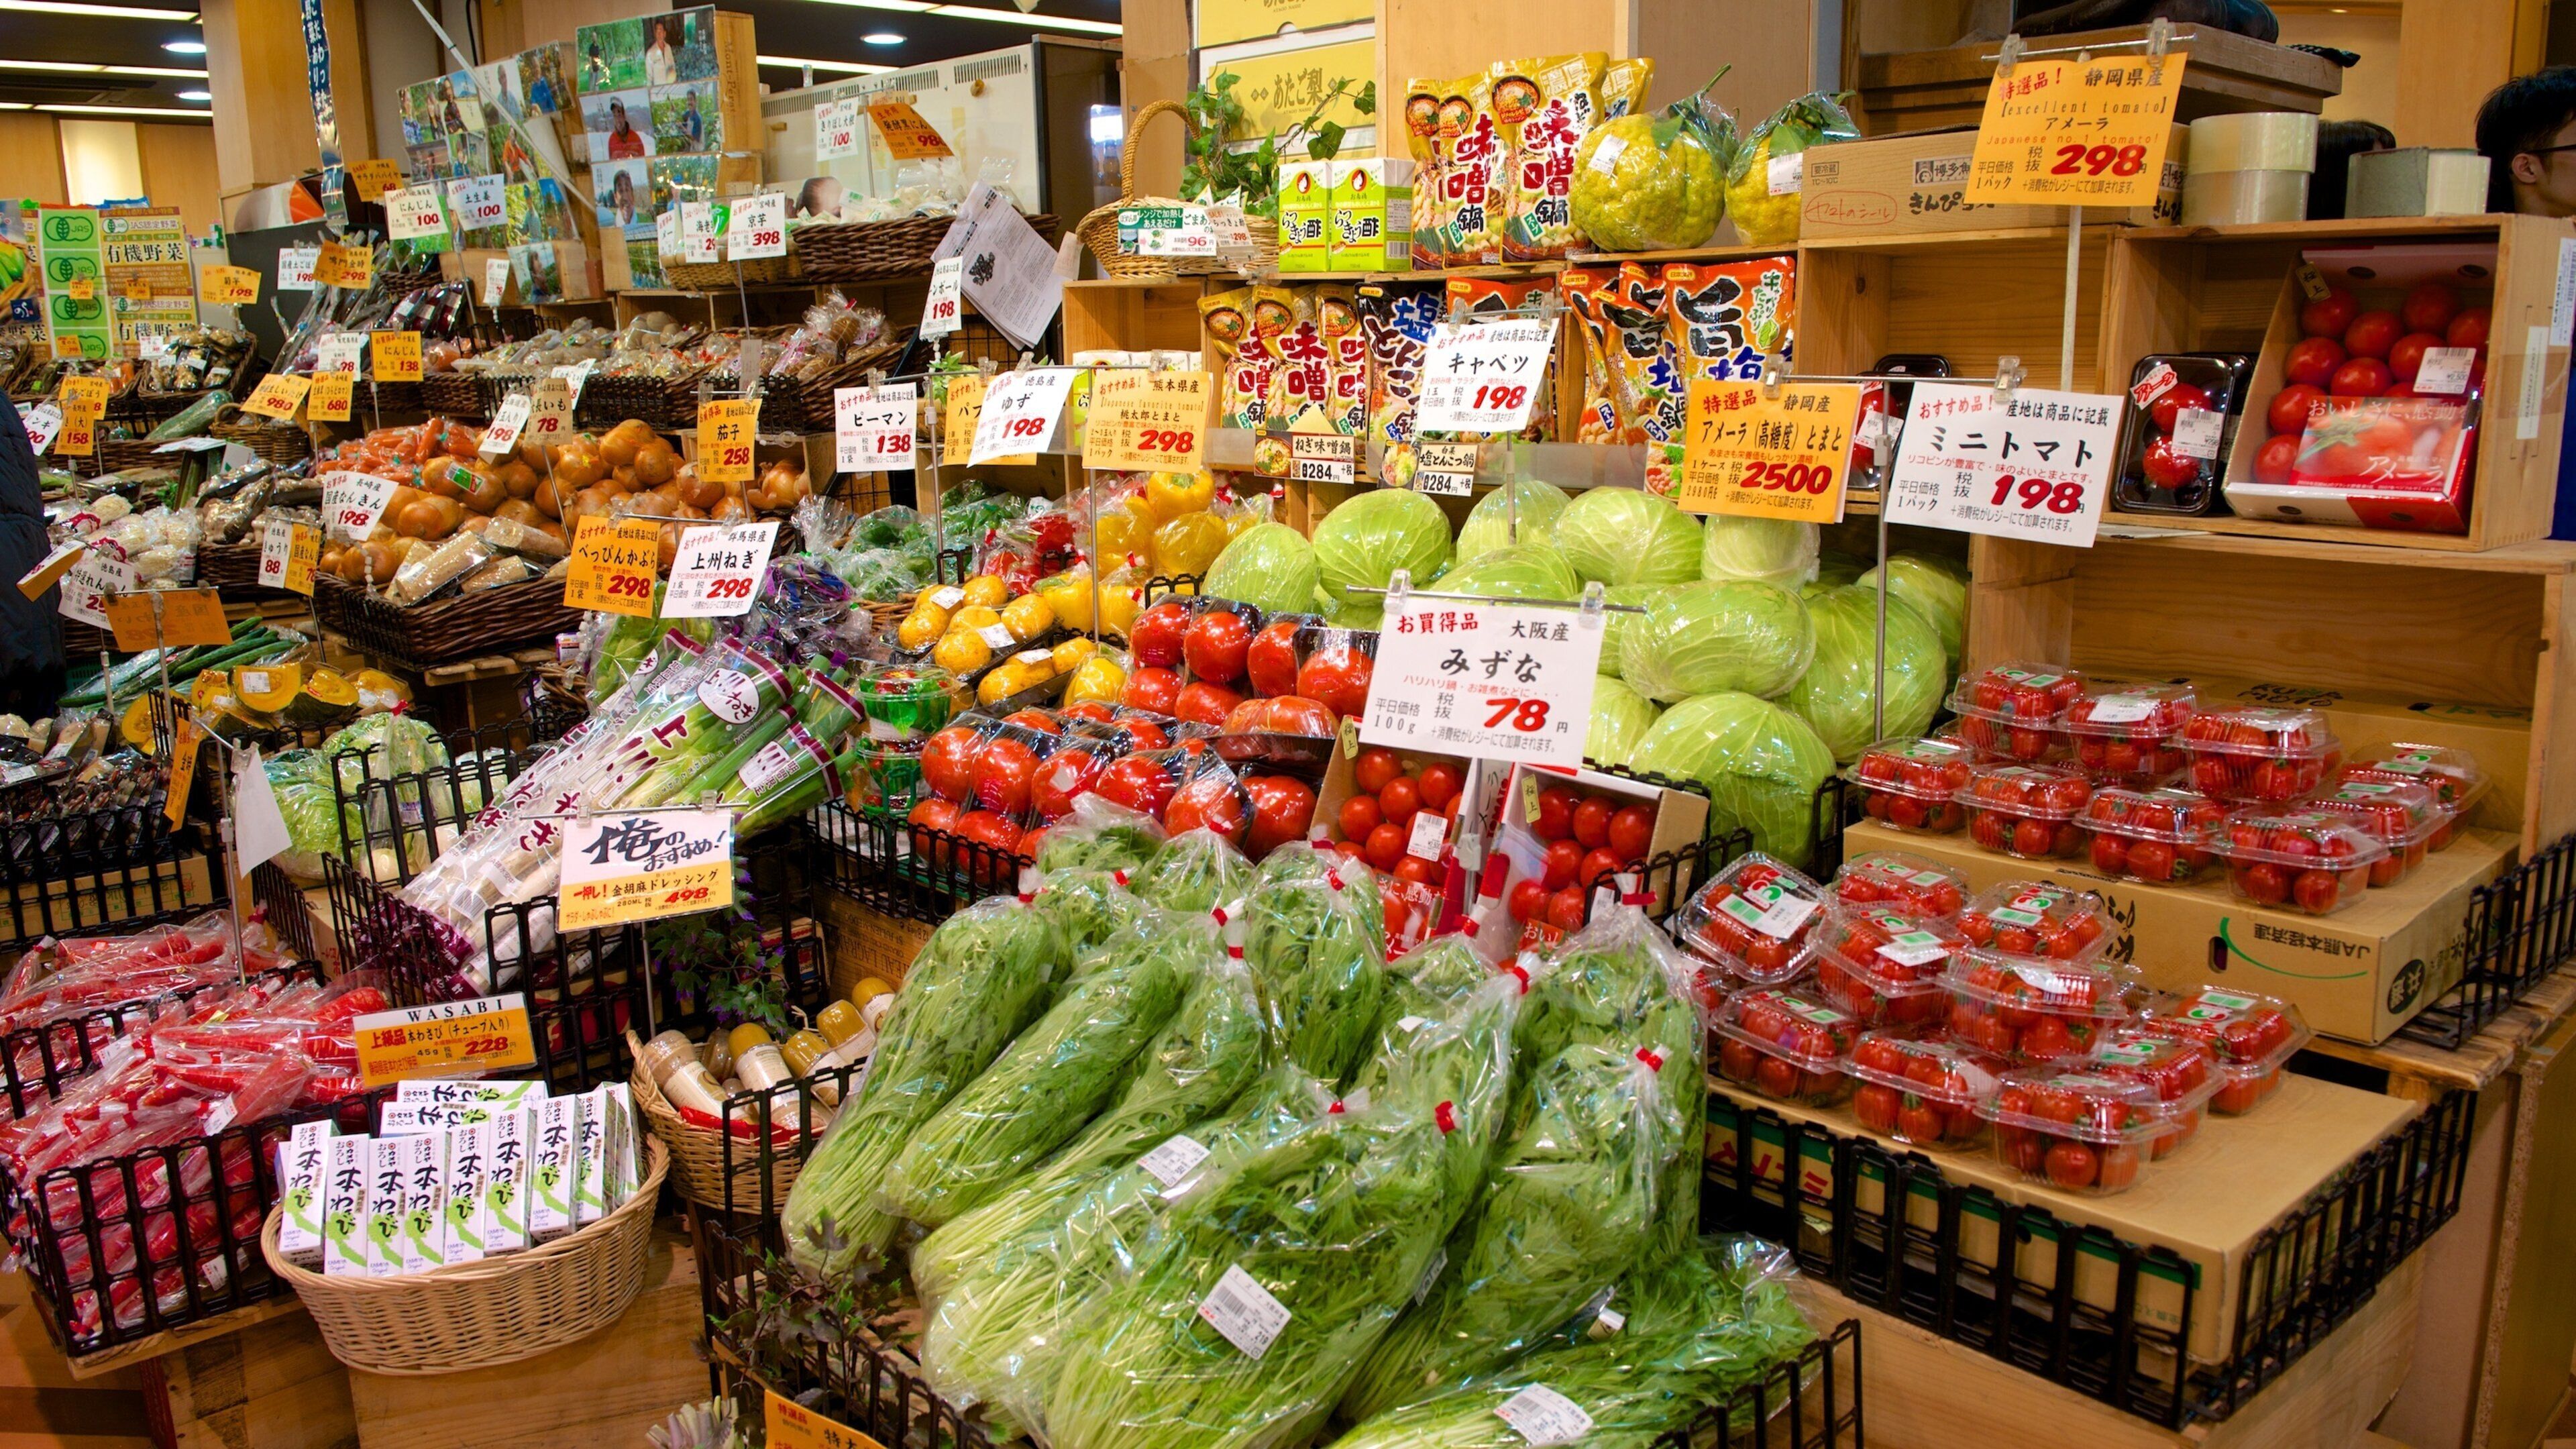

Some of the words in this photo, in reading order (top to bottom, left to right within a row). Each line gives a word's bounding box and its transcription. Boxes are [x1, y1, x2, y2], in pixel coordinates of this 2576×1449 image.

[1998, 68, 2062, 101] 特選品！
[2085, 68, 2163, 88] 静岡県産
[1274, 68, 1323, 109] あたご梨
[2045, 117, 2109, 131] アメーラ
[833, 132, 850, 147] 100
[1986, 136, 2047, 145] Japanese
[2102, 132, 2159, 144] tomato!
[1522, 99, 1579, 227] 味噌鍋
[1978, 161, 2014, 174] 平日価格
[2025, 146, 2043, 172] 税抜
[2050, 144, 2147, 176] 298
[1444, 113, 1496, 233] 味噌鍋
[382, 183, 396, 191] 68
[1976, 176, 2012, 190] 1パック
[400, 200, 433, 212] にんじん
[466, 191, 491, 204] 土生姜
[417, 213, 439, 225] 100
[477, 205, 500, 217] 100
[1138, 209, 1183, 219] レンジで加熱し
[72, 224, 89, 232] JAS
[130, 219, 177, 229] JAS認定野菜
[748, 213, 767, 229] 京芋
[1143, 219, 1176, 228] あえるだけ
[1282, 211, 1322, 244] らっきょう酢
[1335, 209, 1379, 243] らっきょう酢
[753, 231, 780, 246] 398
[1187, 236, 1207, 246] 96
[107, 243, 184, 263] 有機野菜
[329, 256, 365, 268] 鳴門金時
[281, 260, 315, 269] 国産土ごぼ
[297, 273, 314, 282] 198
[341, 272, 366, 280] 298
[933, 301, 955, 319] 198
[1438, 328, 1485, 350] おすすめ品
[1489, 328, 1548, 343] 産地は商品に記載
[384, 346, 416, 356] にんじん
[400, 362, 419, 371] 138
[1448, 353, 1529, 375] キャベツ
[951, 382, 976, 401] おすすめ！
[1099, 377, 1141, 395] おすすめ品！
[1152, 379, 1199, 393] 熊本県産
[1426, 387, 1438, 396] 1玉
[267, 398, 293, 411] 980
[327, 400, 347, 411] 680
[840, 391, 872, 411] おすすめ品
[1002, 394, 1033, 412] ゆず
[1452, 386, 1464, 407] 税抜
[1473, 385, 1527, 409] 198
[1703, 389, 1757, 415] 特選品
[1784, 394, 1830, 413] 静岡産
[1120, 409, 1180, 422] 桃太郎とまと
[1919, 394, 1994, 420] おすすめ品！
[2006, 400, 2110, 427] 産地は商品に記載
[853, 411, 908, 427] ピーマン
[1002, 417, 1045, 438] 198
[67, 432, 89, 443] 158
[487, 427, 514, 441] 198
[717, 424, 739, 441] 茄子
[1138, 430, 1194, 453] 298
[877, 434, 912, 453] 138
[1089, 439, 1113, 447] 平日価格
[1295, 437, 1351, 455] ねぎ味噌鍋
[1442, 445, 1455, 454] 白菜
[1930, 426, 2093, 468] ミニトマト
[723, 447, 749, 465] 258
[1089, 449, 1112, 458] 1パック
[1420, 451, 1474, 468] 塩とんこつ鍋
[1709, 448, 1819, 464] あまさも栄養価もしっかり濃縮！
[1691, 459, 1725, 470] 1ケース
[1728, 462, 1742, 485] 税抜
[2359, 456, 2445, 484] アメーラ
[1688, 471, 1720, 484] 平日価格
[1740, 462, 1832, 495] 2500
[1953, 471, 1973, 498] 税抜
[1898, 480, 1940, 496] 平日価格
[1991, 474, 2084, 515] 198
[1897, 497, 1937, 512] 1パック
[337, 510, 369, 527] 198
[580, 526, 611, 540] おすすめ！
[684, 531, 720, 550] おすすめ品！
[728, 530, 767, 543] 群馬県産
[265, 559, 280, 574] 88
[691, 549, 759, 570] 上州ねぎ
[595, 573, 603, 590] 税抜
[608, 575, 650, 598] 298
[694, 580, 705, 598] 税抜
[707, 578, 753, 599] 298
[570, 589, 584, 599] 1袋
[1397, 612, 1479, 634] お買得品
[1509, 620, 1570, 642] 大阪産
[1440, 648, 1542, 683] みずな
[1375, 698, 1421, 716] 平日価格
[1434, 692, 1454, 719] 税抜
[1375, 714, 1416, 735] 100g
[1484, 698, 1551, 733] 78
[1556, 721, 1568, 733] 円
[582, 818, 686, 865] 俺の
[643, 830, 727, 872] おすすめ！
[611, 869, 719, 897] 金胡麻ドレッシング
[574, 885, 607, 900] 一押し！
[665, 887, 710, 903] 498
[2253, 922, 2371, 959] JA熊本経済連
[407, 998, 503, 1022] WASABI
[371, 1028, 407, 1049] 上級品
[408, 1016, 510, 1044] 本わさび（チューブ入り）
[417, 1049, 438, 1057] 45g
[465, 1036, 508, 1056] 228
[537, 1124, 567, 1186] 本わさび
[490, 1139, 521, 1205] 本わさび
[451, 1152, 482, 1219] 本わさび
[330, 1167, 362, 1235] 本わさび
[372, 1169, 403, 1238] 本わさび
[409, 1165, 438, 1233] 本わさび
